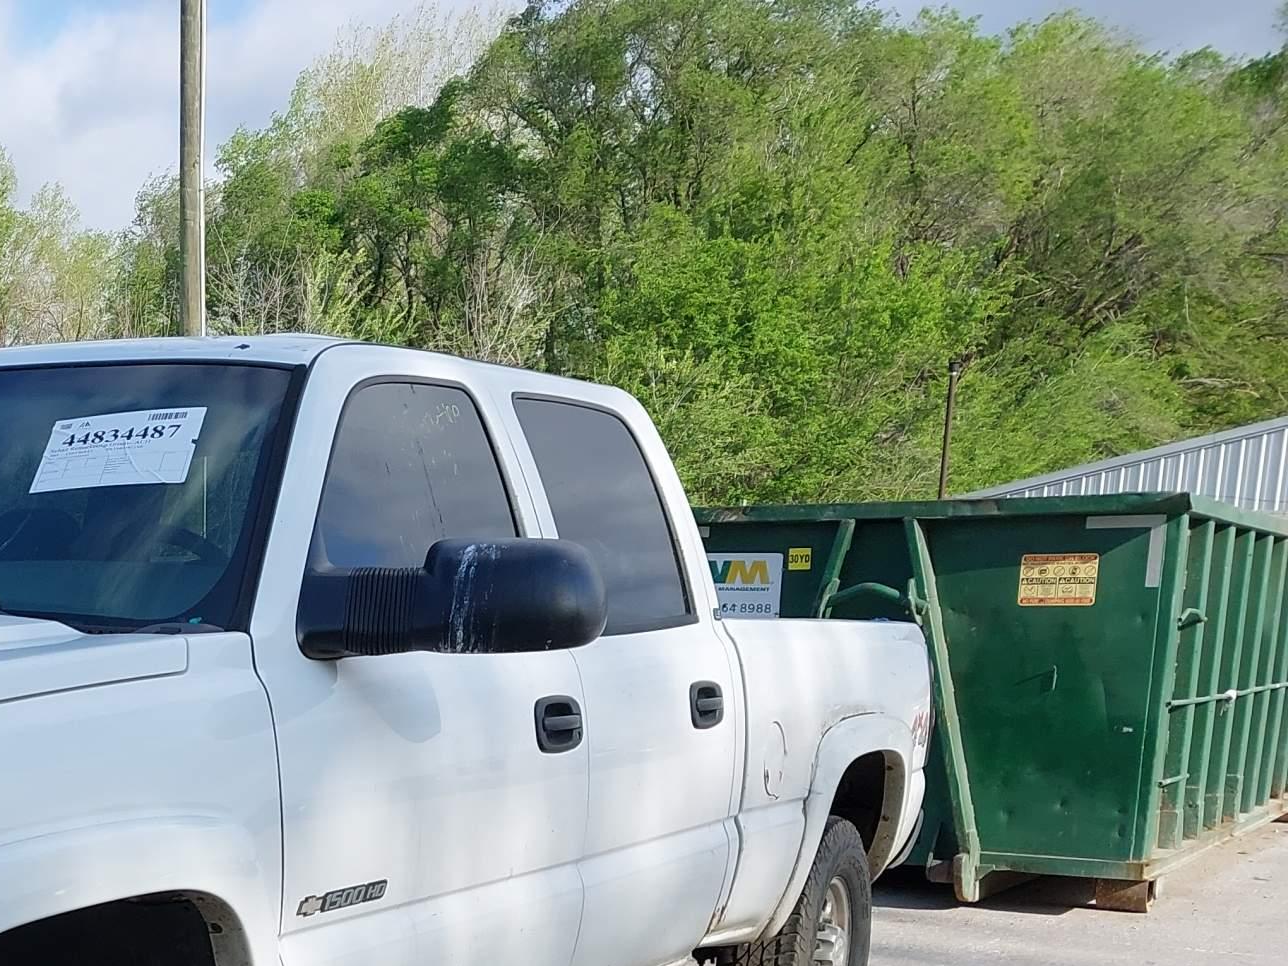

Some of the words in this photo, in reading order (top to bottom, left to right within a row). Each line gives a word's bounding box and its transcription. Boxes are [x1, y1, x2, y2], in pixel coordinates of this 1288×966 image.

[62, 424, 182, 447] 44834487
[789, 554, 810, 563] 30YD
[740, 603, 772, 614] 8988
[324, 885, 366, 911] 1500
[367, 882, 387, 899] HD
